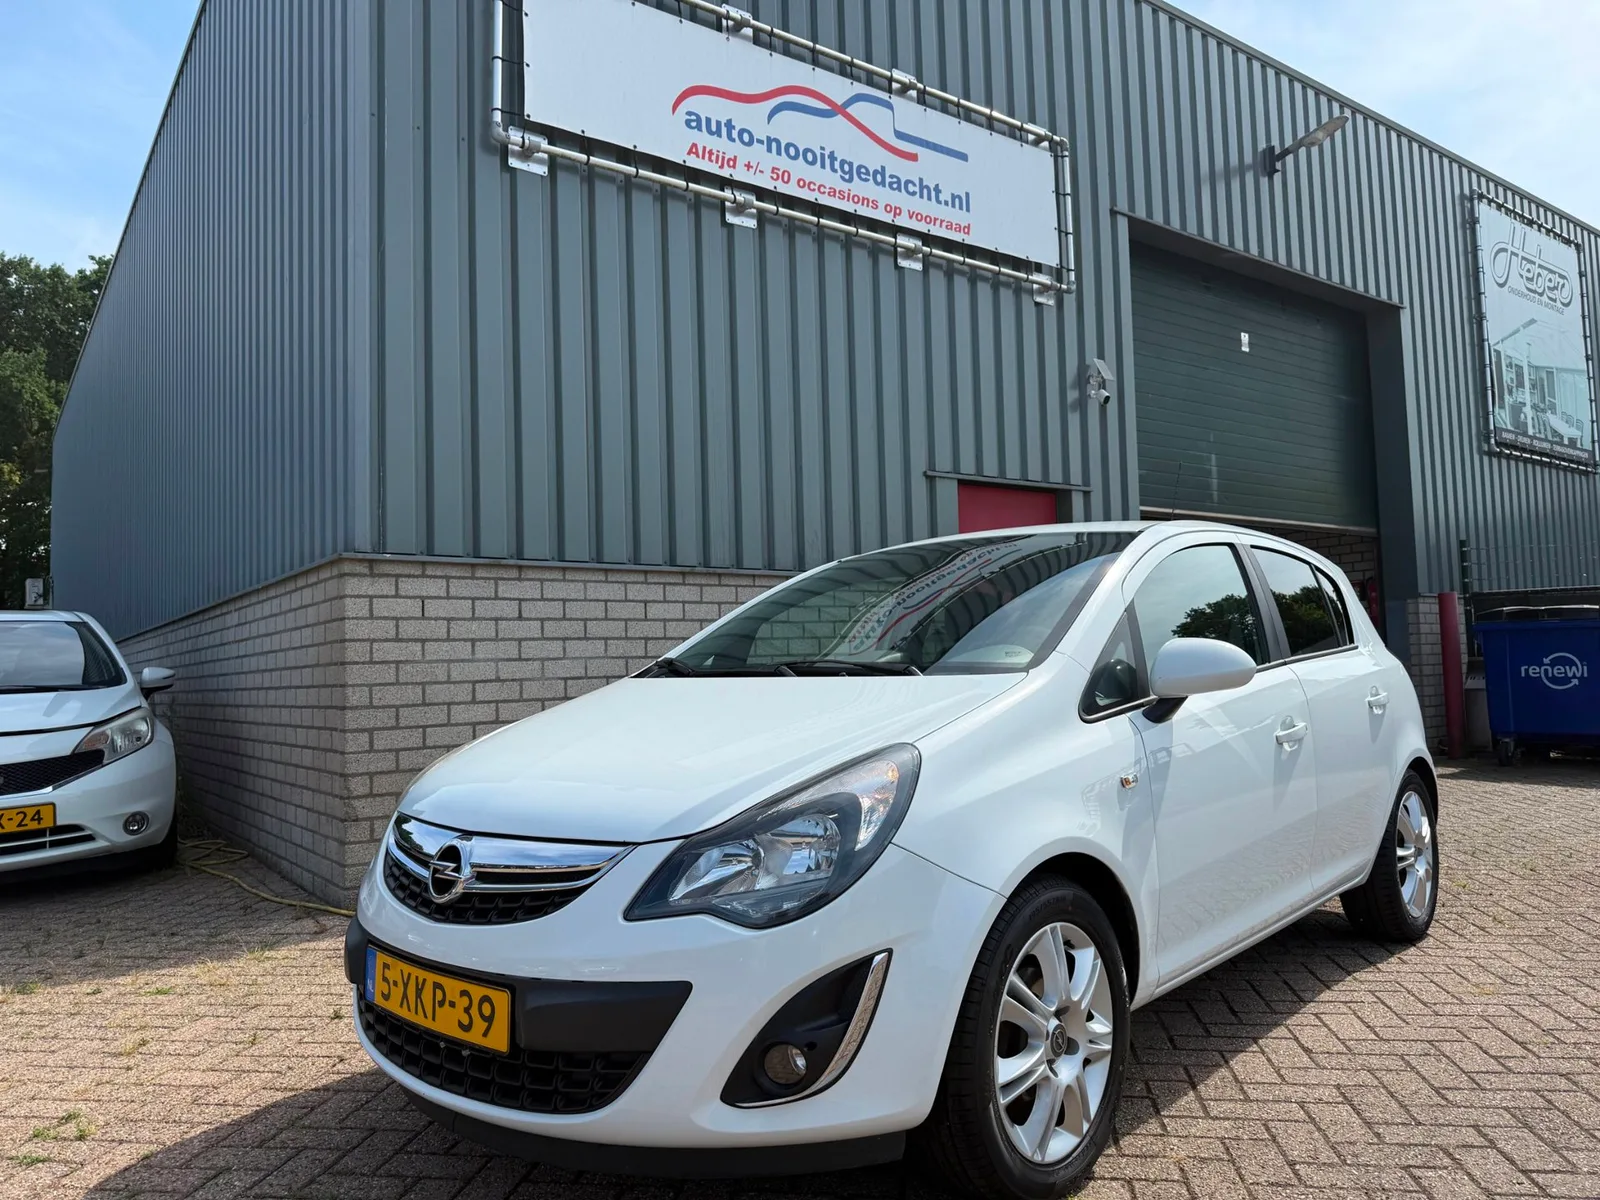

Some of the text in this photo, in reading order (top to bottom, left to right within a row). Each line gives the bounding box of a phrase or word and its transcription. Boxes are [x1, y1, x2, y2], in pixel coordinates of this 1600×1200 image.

[684, 109, 971, 214] auto-nooitgedacht.nl
[686, 142, 971, 236] Altijd +/- 50 occasions op voorraad
[1520, 661, 1588, 678] renewi
[380, 961, 496, 1038] 5-XKP-39
